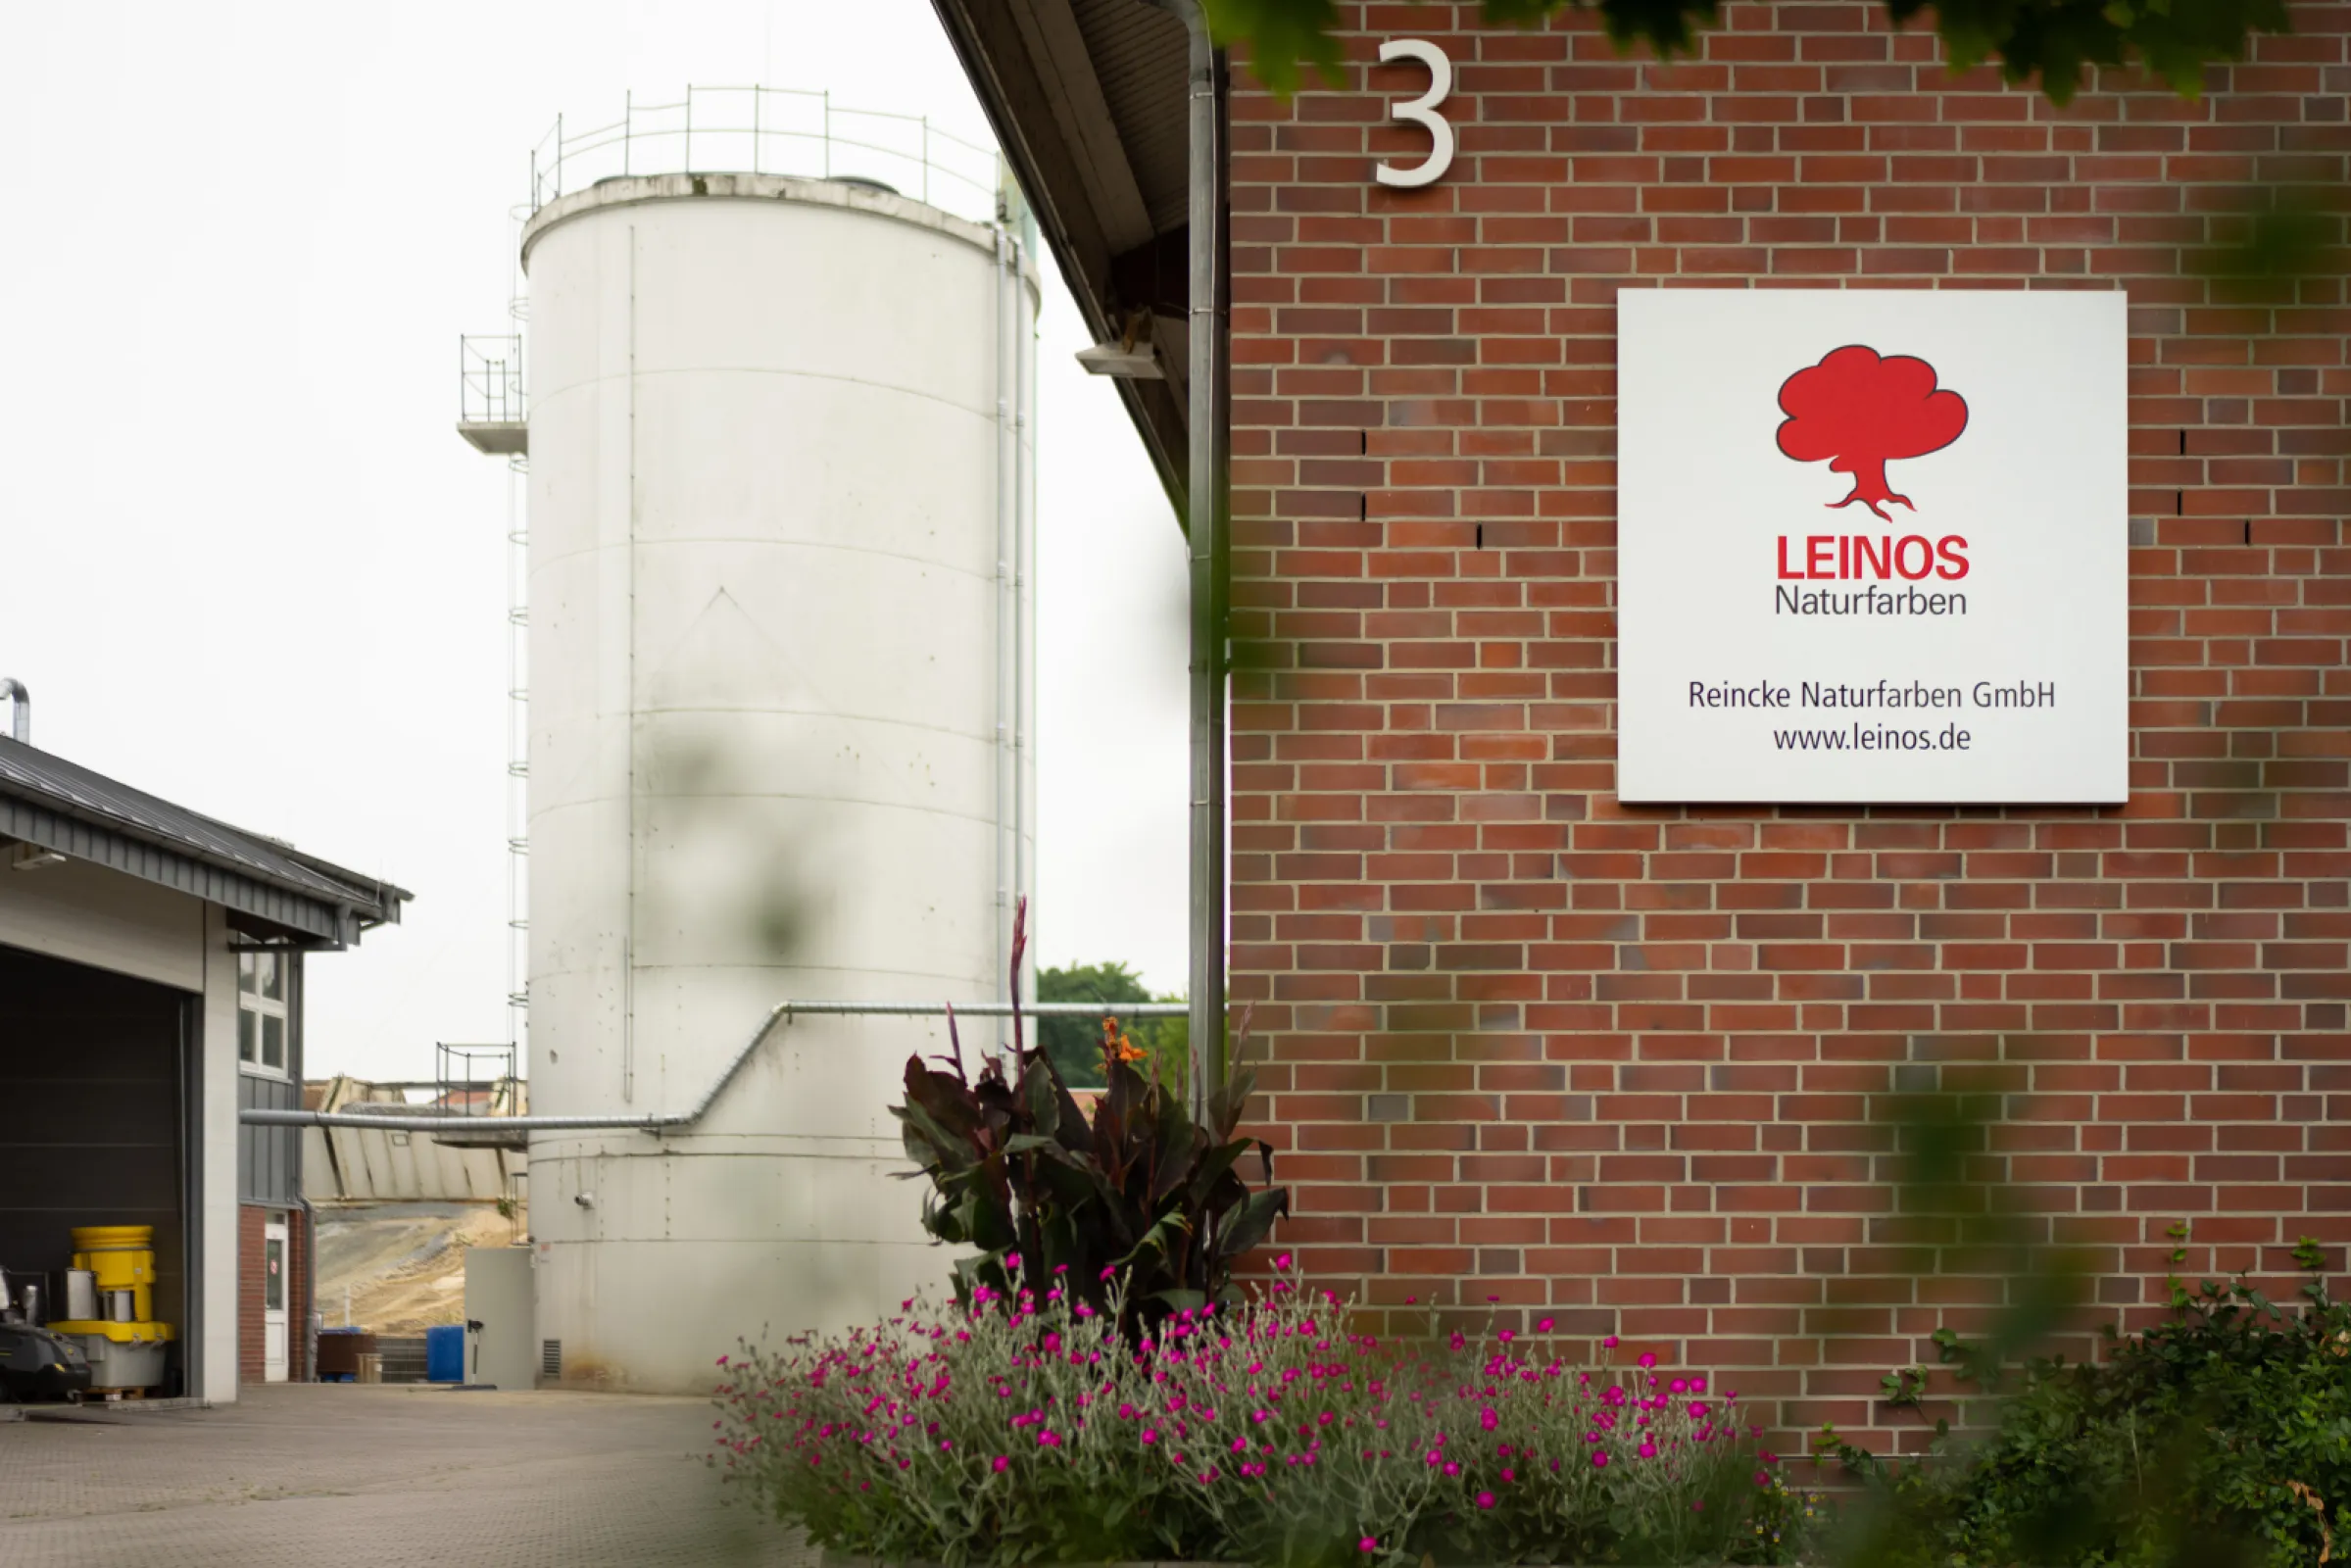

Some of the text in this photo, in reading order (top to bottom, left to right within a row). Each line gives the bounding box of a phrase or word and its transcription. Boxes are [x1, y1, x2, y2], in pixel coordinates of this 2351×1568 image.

[1375, 38, 1454, 188] 3
[1776, 535, 1971, 580] LEINOS
[1775, 584, 1967, 615] Naturfarben
[1689, 679, 2055, 708] Reincke Naturfarben GmbH
[1773, 722, 1972, 751] www.leinos.de
